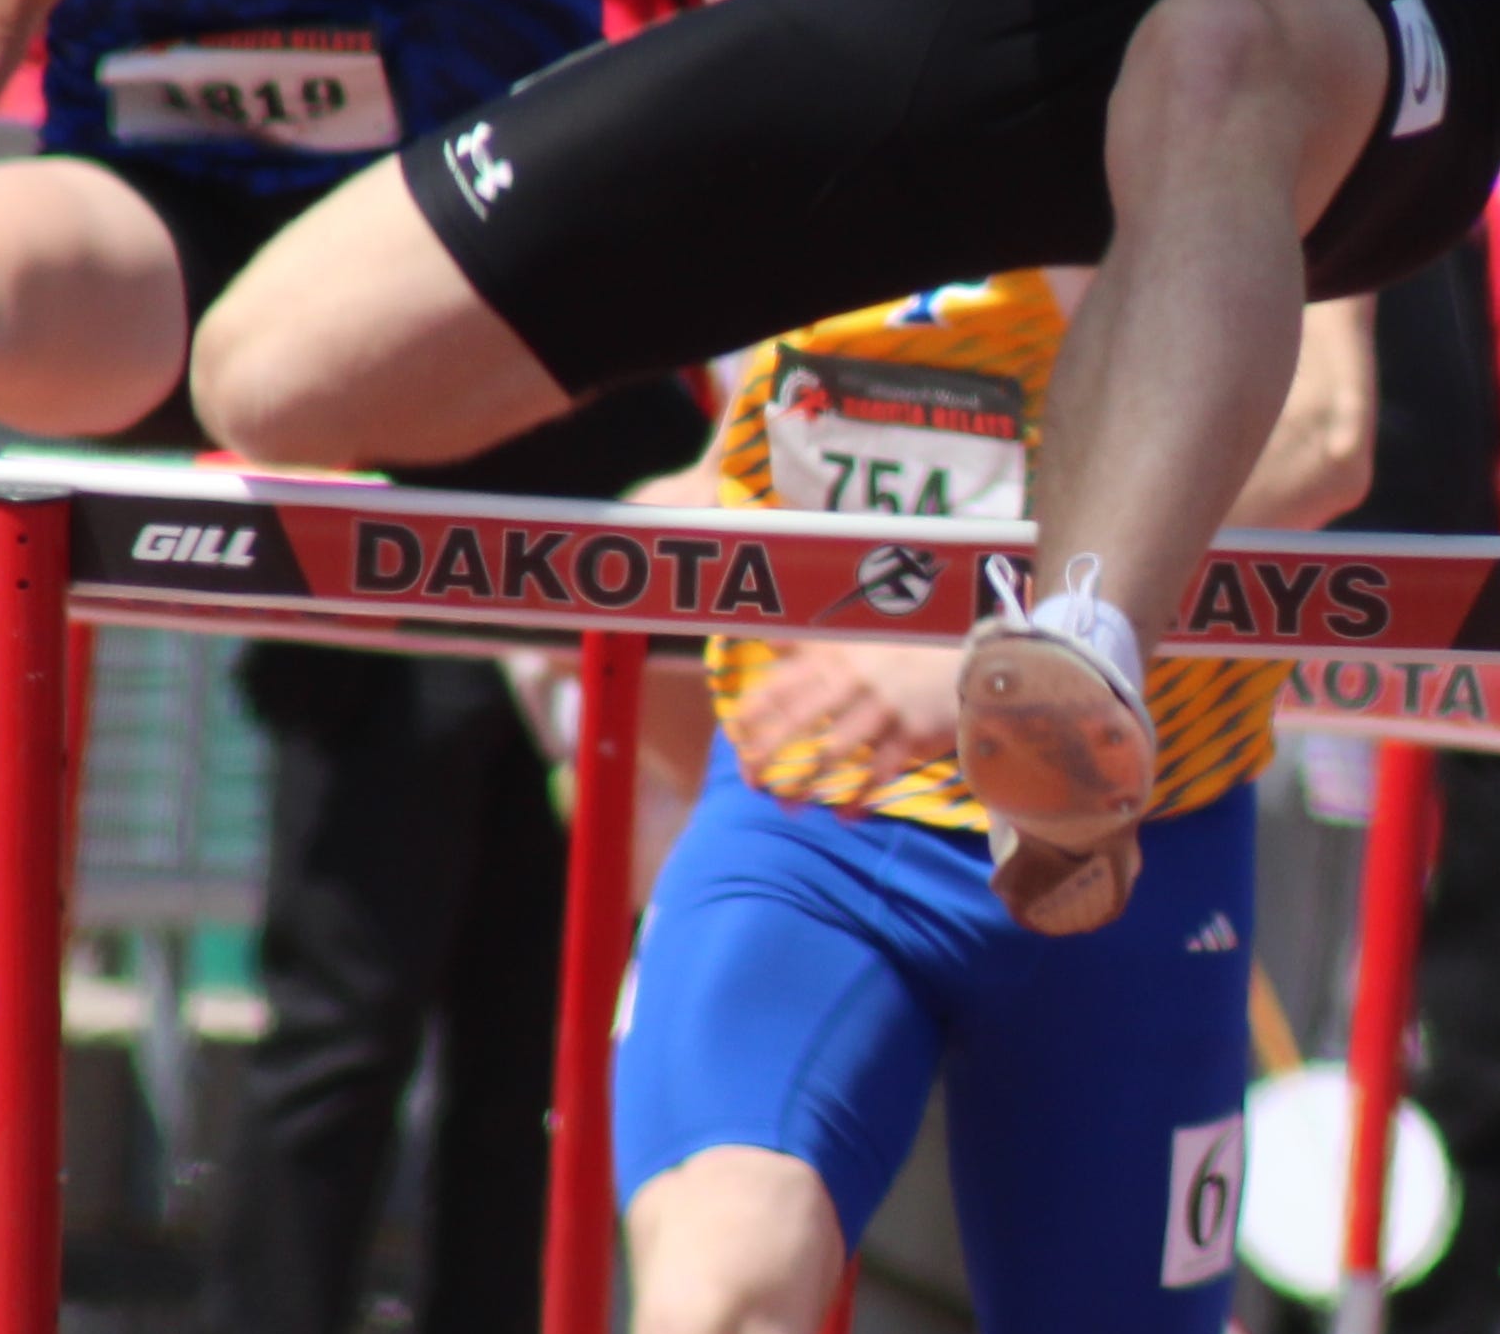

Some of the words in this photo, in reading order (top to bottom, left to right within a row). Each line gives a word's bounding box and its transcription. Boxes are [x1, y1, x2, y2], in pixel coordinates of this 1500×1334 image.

[132, 523, 257, 568] GILL
[352, 519, 784, 616] DAKOTA
[1188, 1123, 1236, 1248] 6
